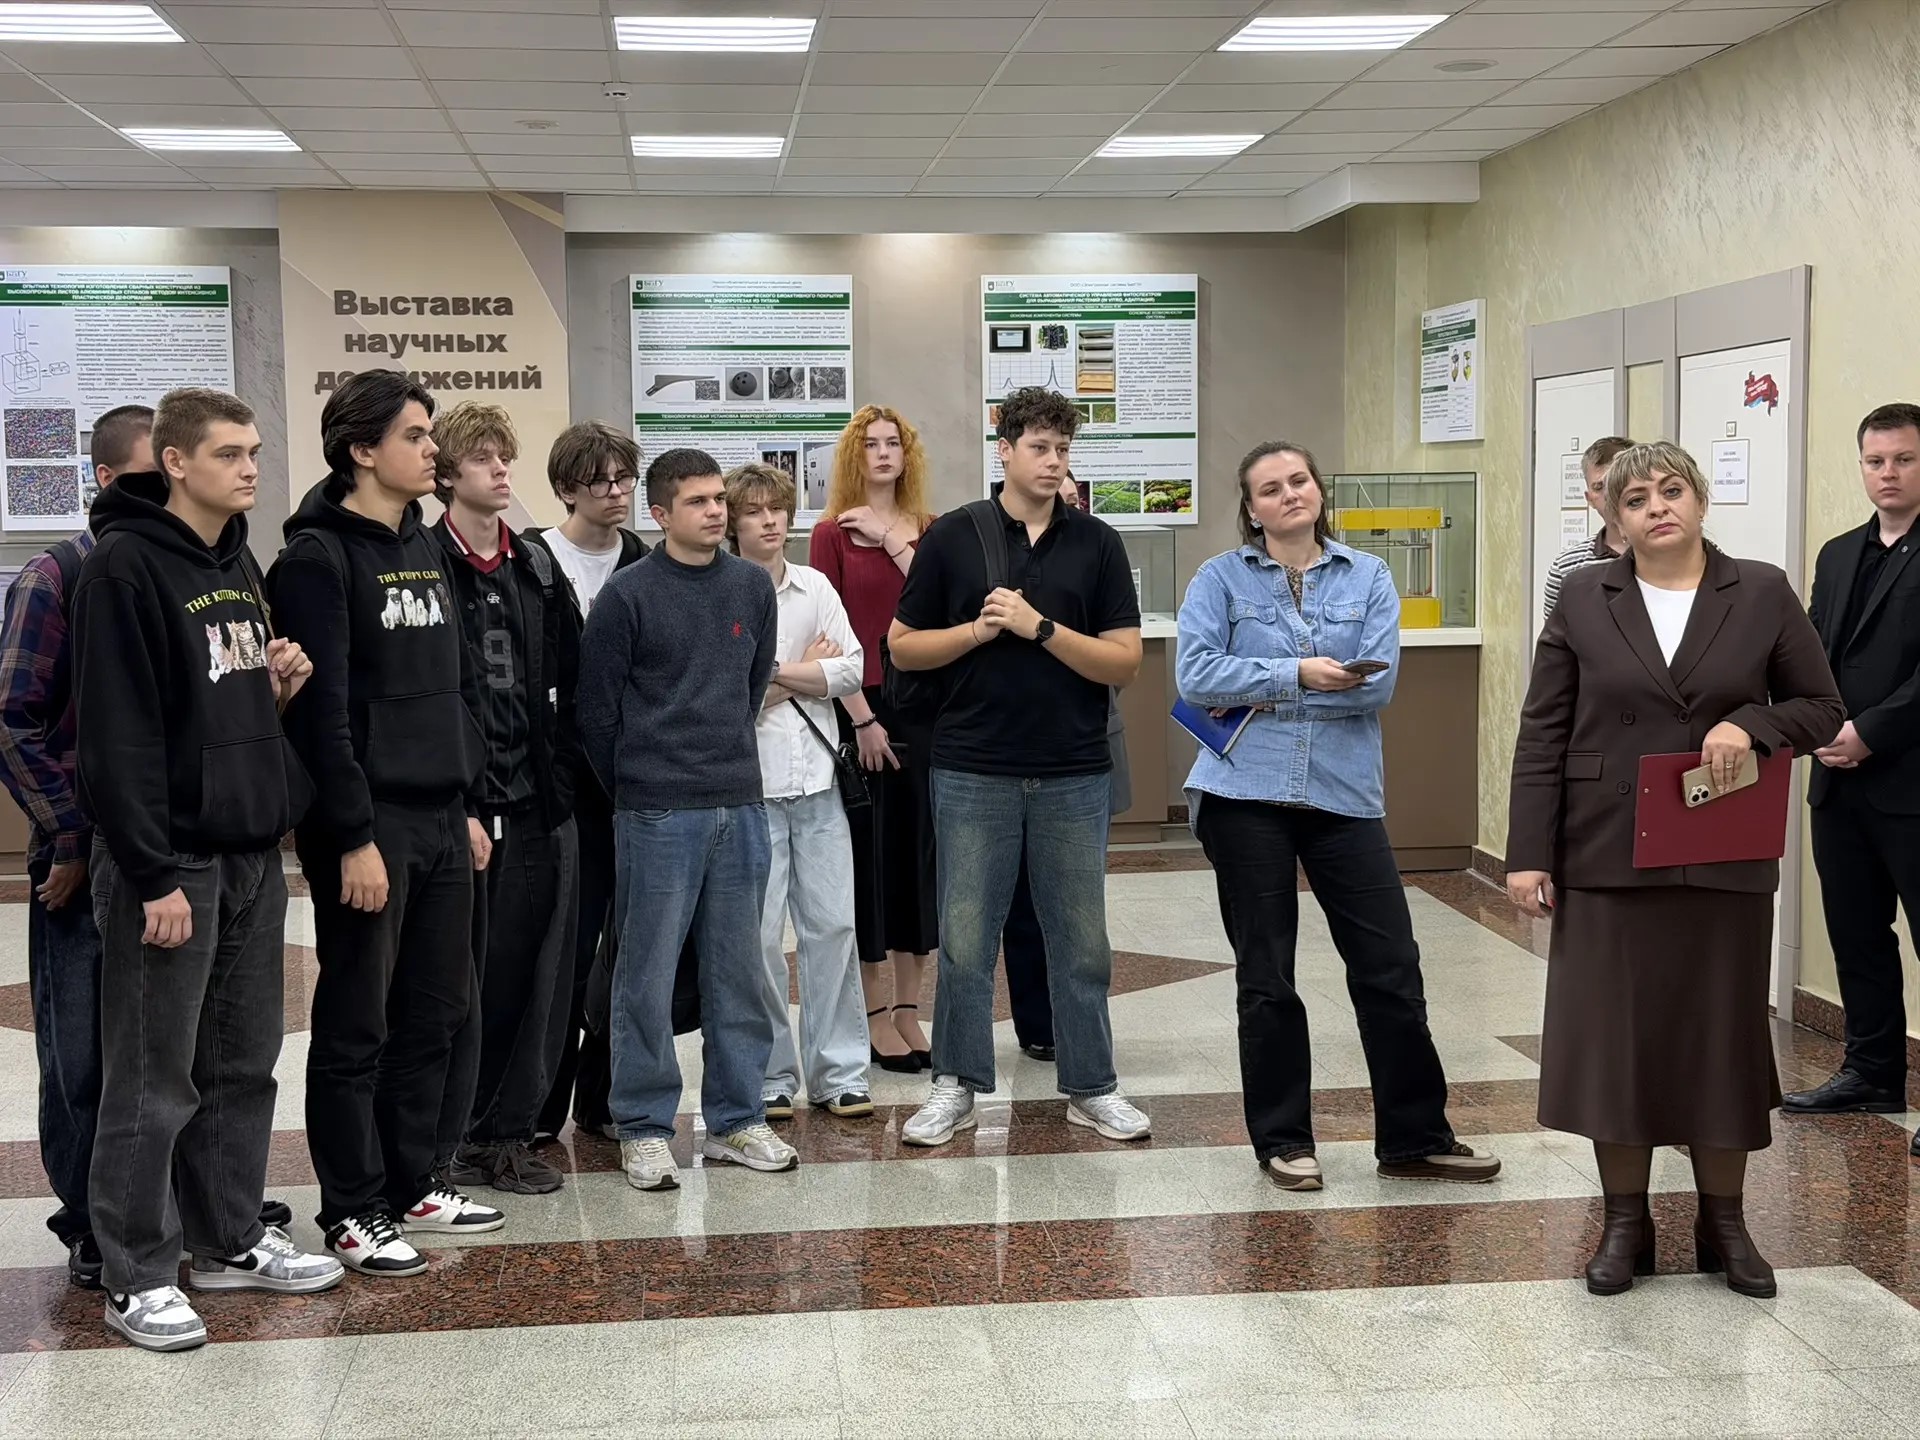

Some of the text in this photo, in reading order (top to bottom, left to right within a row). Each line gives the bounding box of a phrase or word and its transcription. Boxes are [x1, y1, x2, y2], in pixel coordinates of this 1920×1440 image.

[334, 290, 514, 316] Выставка
[344, 333, 508, 359] научных
[377, 572, 399, 584] THE
[185, 594, 213, 614] THE
[482, 629, 515, 689] 9
